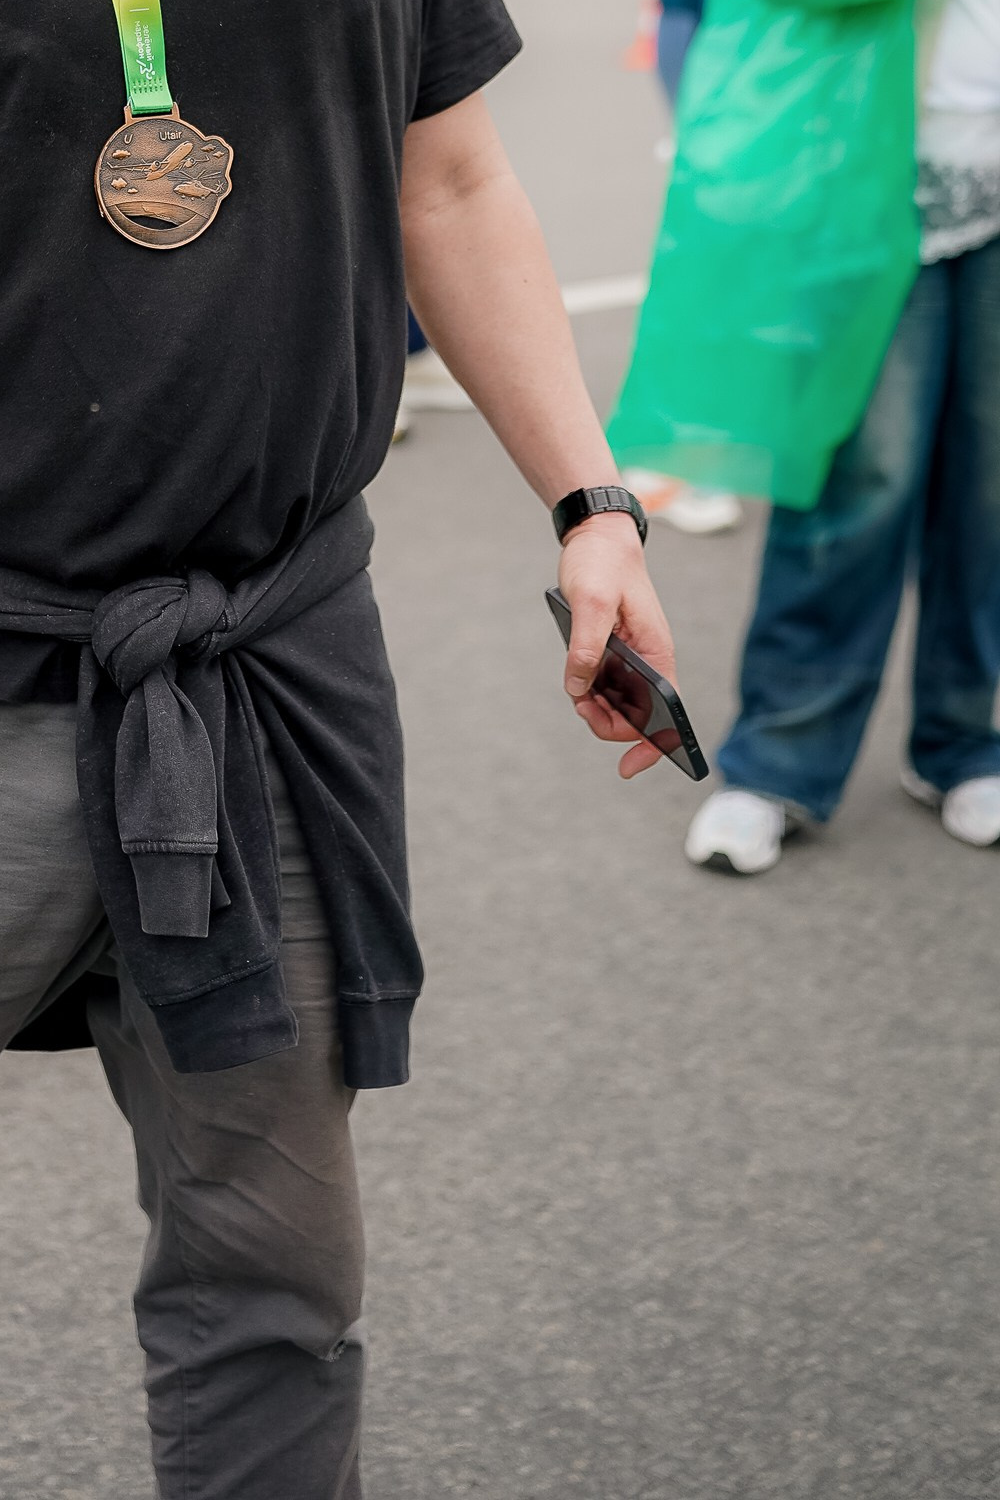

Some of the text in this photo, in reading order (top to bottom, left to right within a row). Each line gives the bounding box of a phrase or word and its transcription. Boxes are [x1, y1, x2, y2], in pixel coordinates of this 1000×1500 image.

[135, 20, 145, 59] марафон
[143, 24, 154, 61] зелёный
[159, 131, 182, 141] Utair
